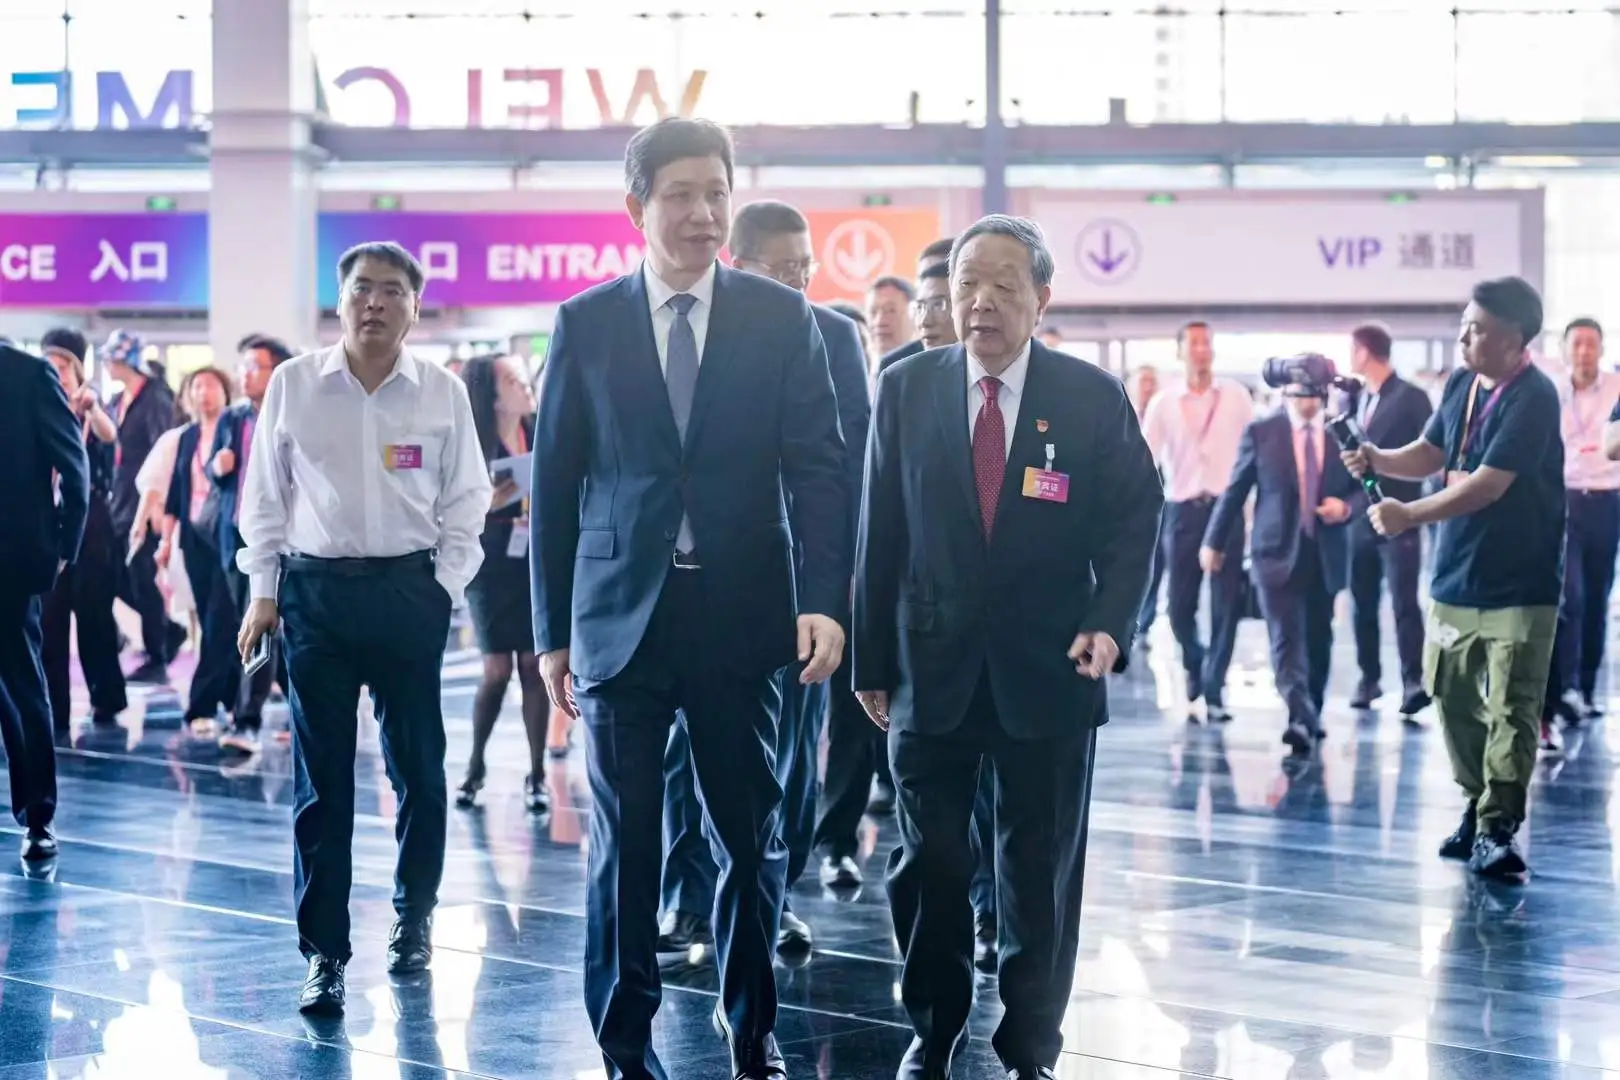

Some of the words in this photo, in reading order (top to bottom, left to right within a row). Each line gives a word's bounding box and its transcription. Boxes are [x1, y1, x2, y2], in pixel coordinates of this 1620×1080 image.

[89, 239, 168, 282] 入口
[1317, 234, 1382, 269] VIP
[1399, 232, 1474, 270] 通道
